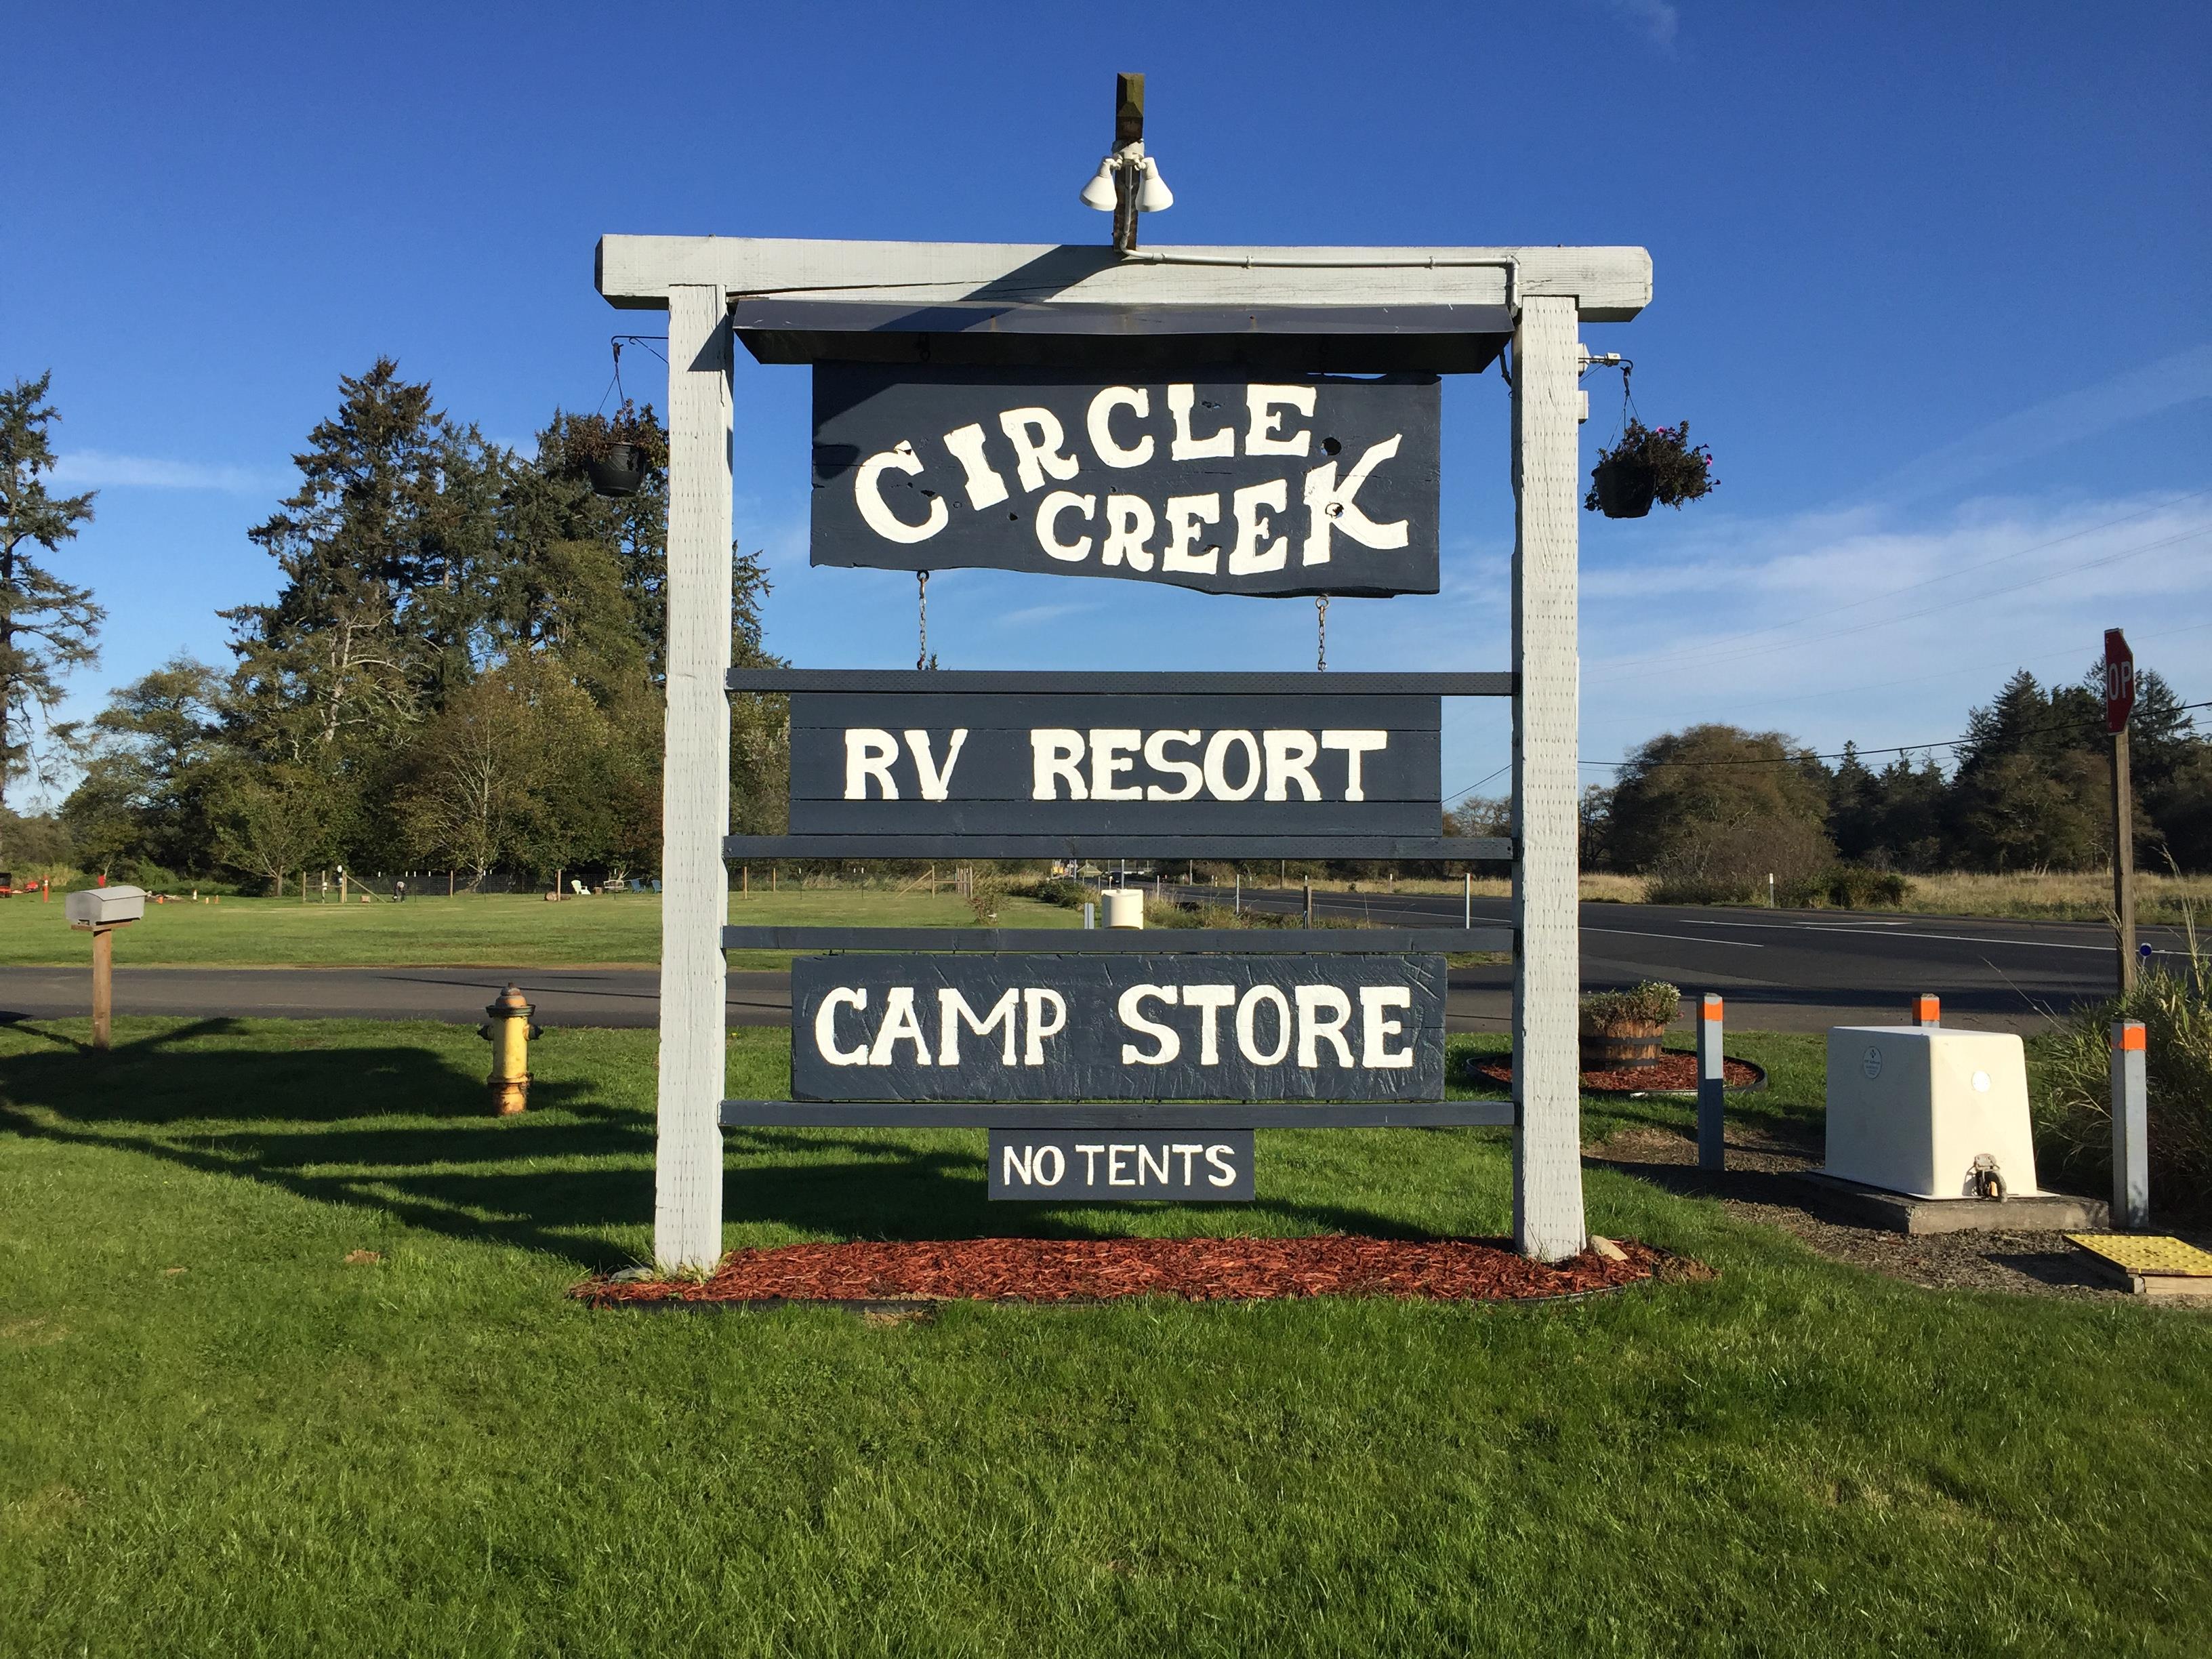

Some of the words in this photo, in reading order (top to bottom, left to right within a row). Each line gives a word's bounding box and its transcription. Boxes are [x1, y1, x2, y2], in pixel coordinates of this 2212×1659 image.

[855, 384, 1317, 544] CIRCLE
[1036, 434, 1409, 575] CREEK
[2108, 661, 2131, 701] OP
[844, 729, 968, 800] RV
[1030, 729, 1389, 802] RESORT
[815, 986, 1067, 1066] CAMP
[1118, 983, 1414, 1068] STORE
[1003, 1145, 1065, 1186] NO
[1075, 1143, 1237, 1187] TENTS
